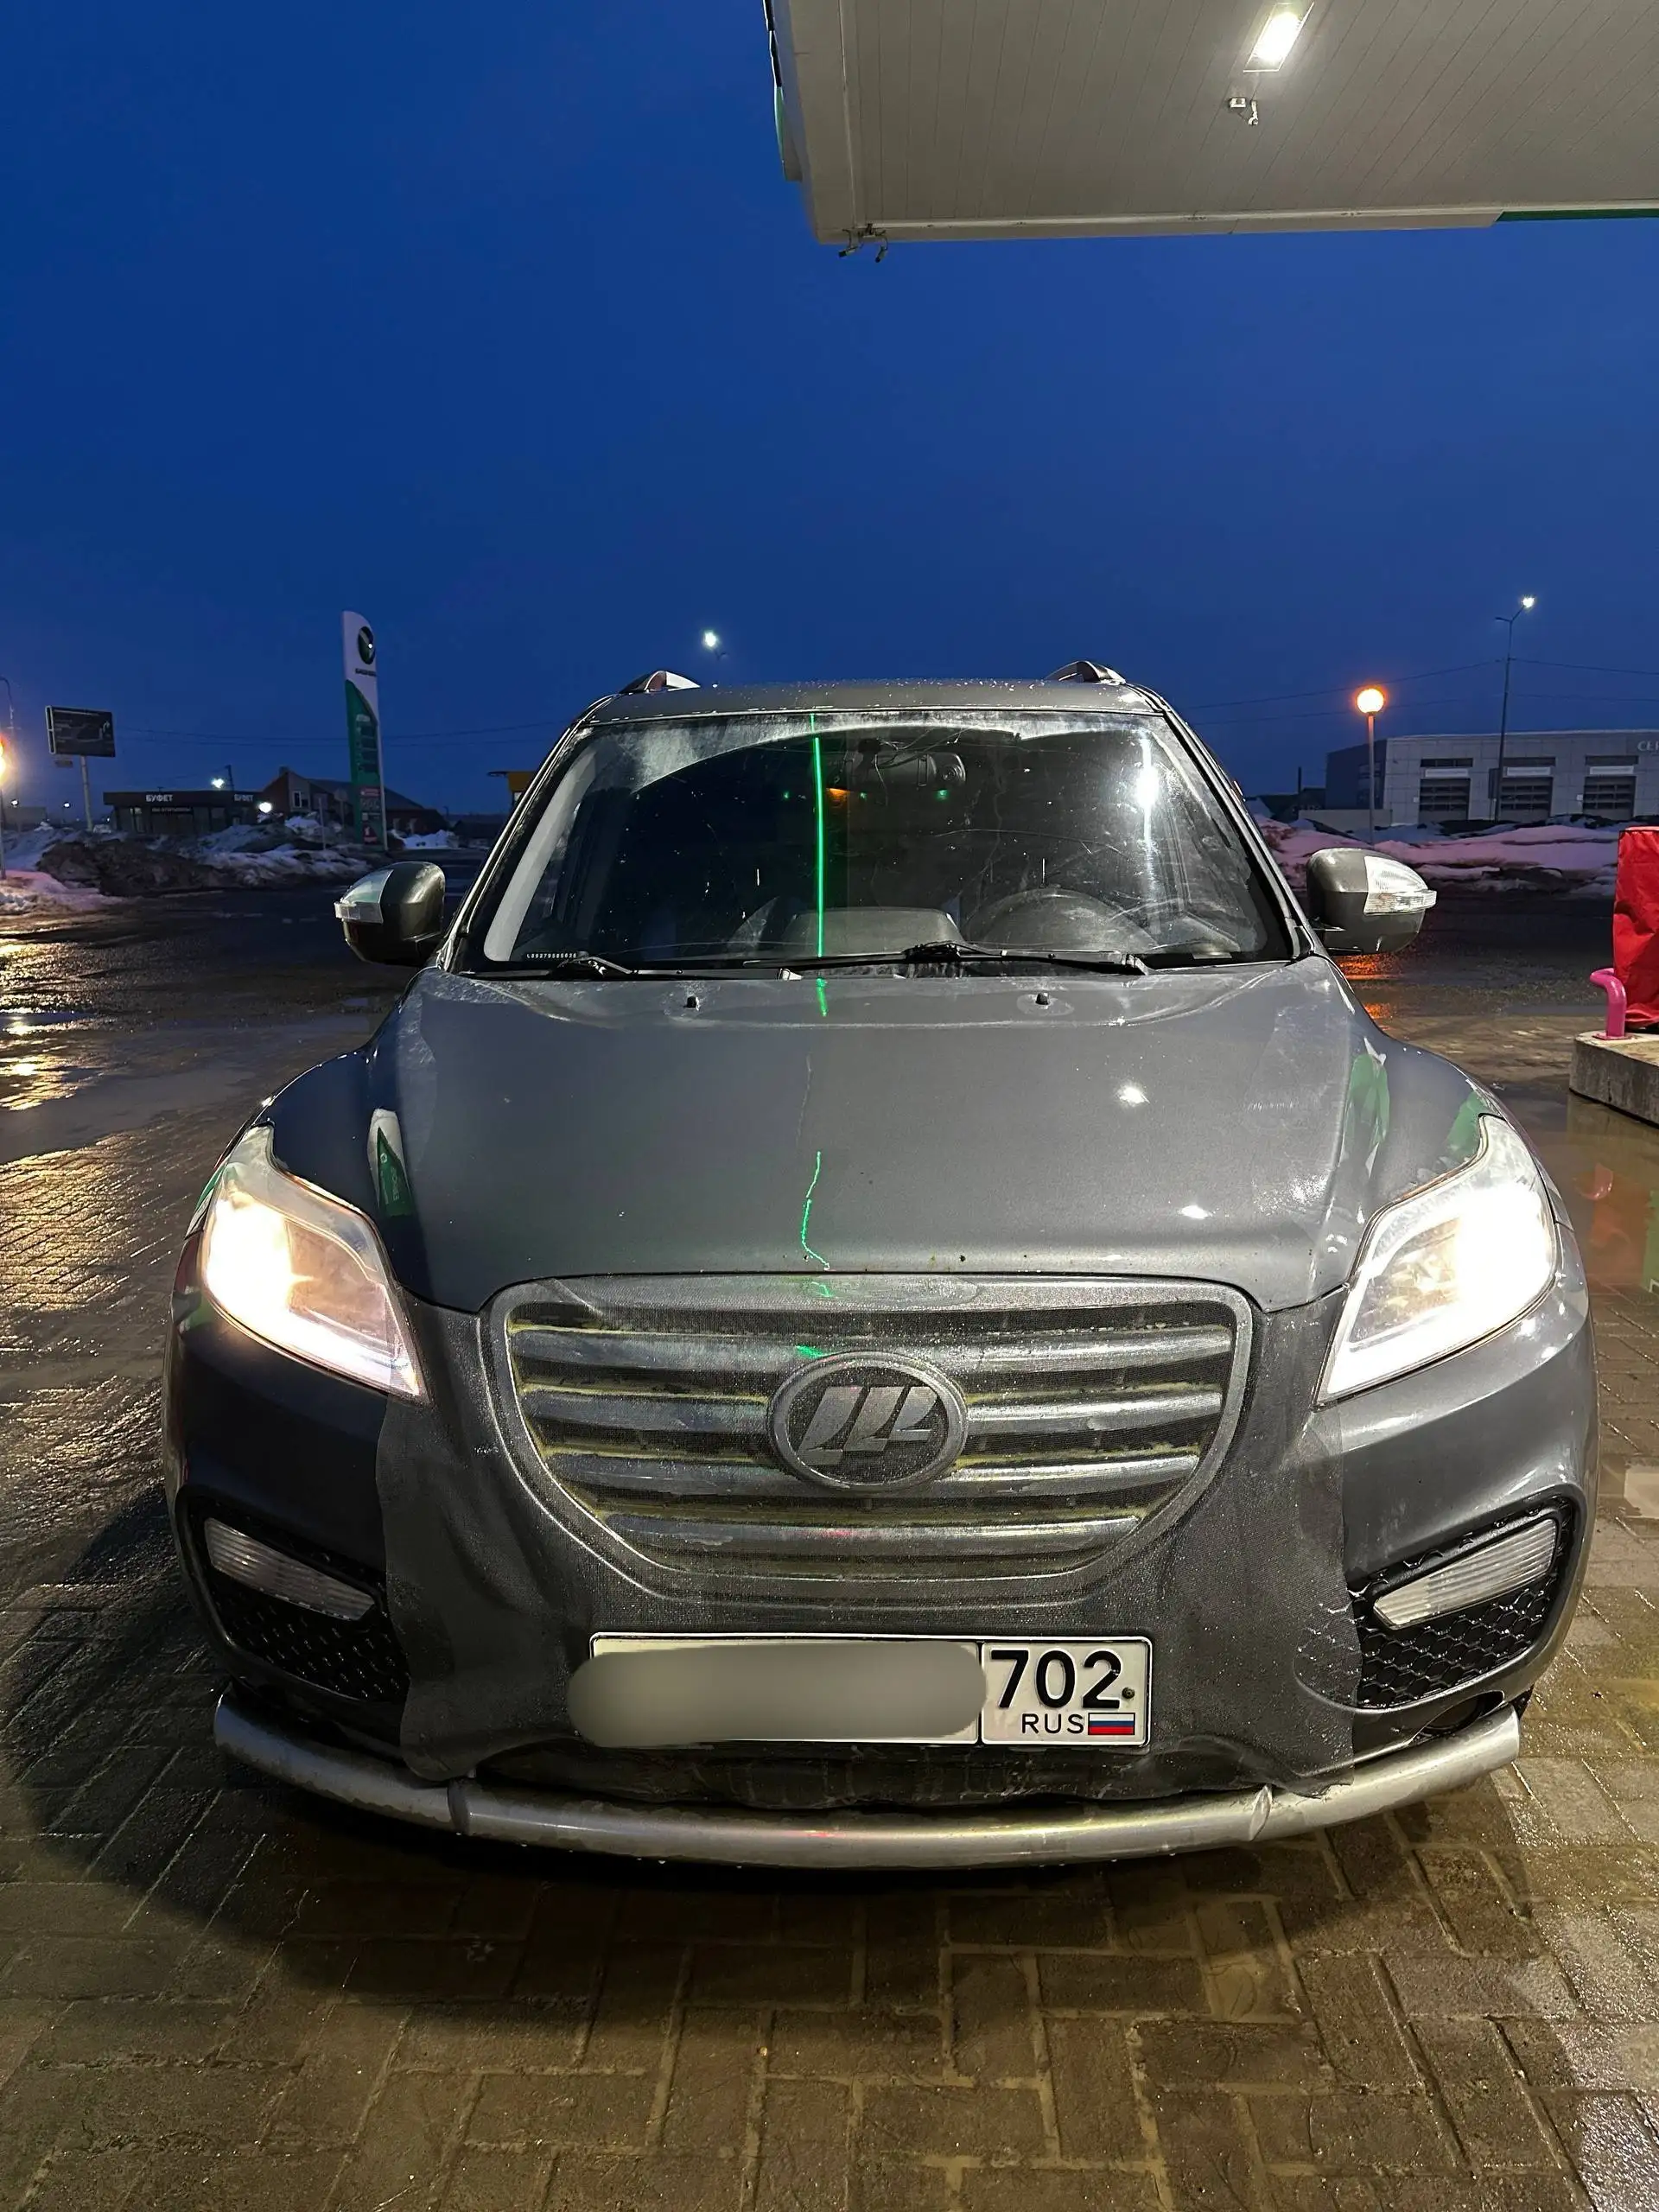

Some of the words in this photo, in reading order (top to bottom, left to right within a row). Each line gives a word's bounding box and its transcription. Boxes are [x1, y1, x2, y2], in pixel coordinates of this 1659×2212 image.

[145, 794, 173, 803] БУФЕТ
[991, 1649, 1122, 1709] 702
[1021, 1713, 1084, 1734] RUS
